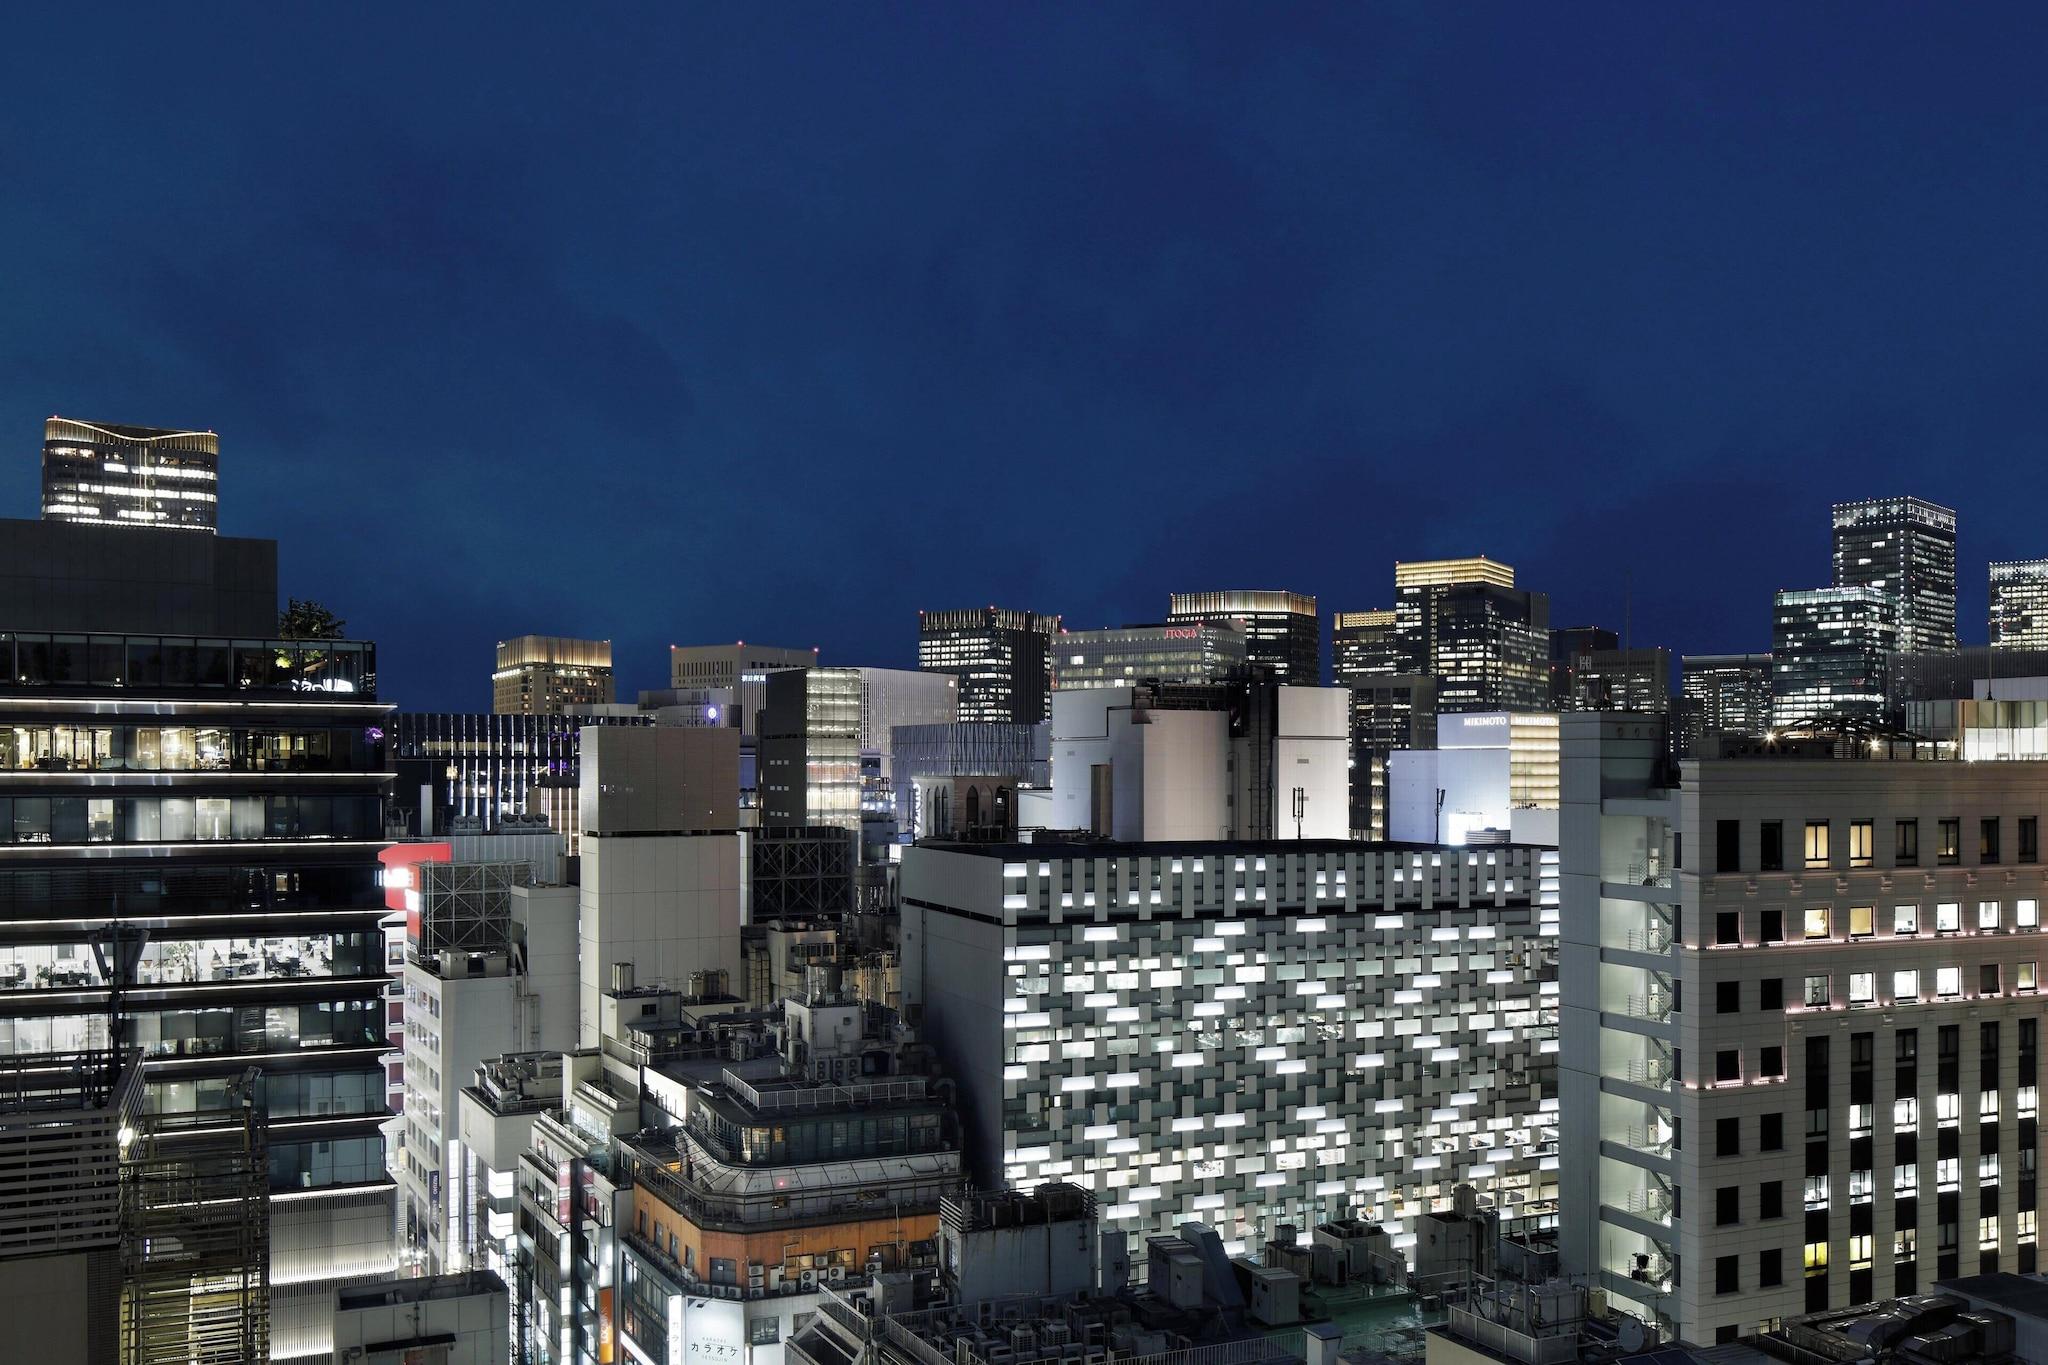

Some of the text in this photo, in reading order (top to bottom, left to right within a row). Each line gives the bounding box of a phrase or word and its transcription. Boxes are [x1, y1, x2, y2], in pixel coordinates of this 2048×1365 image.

[1166, 629, 1198, 638] ITOCIA
[1463, 716, 1507, 726] MIKIMOTO
[1515, 716, 1556, 726] MIKIMOTO
[691, 1342, 738, 1357] カラオケ
